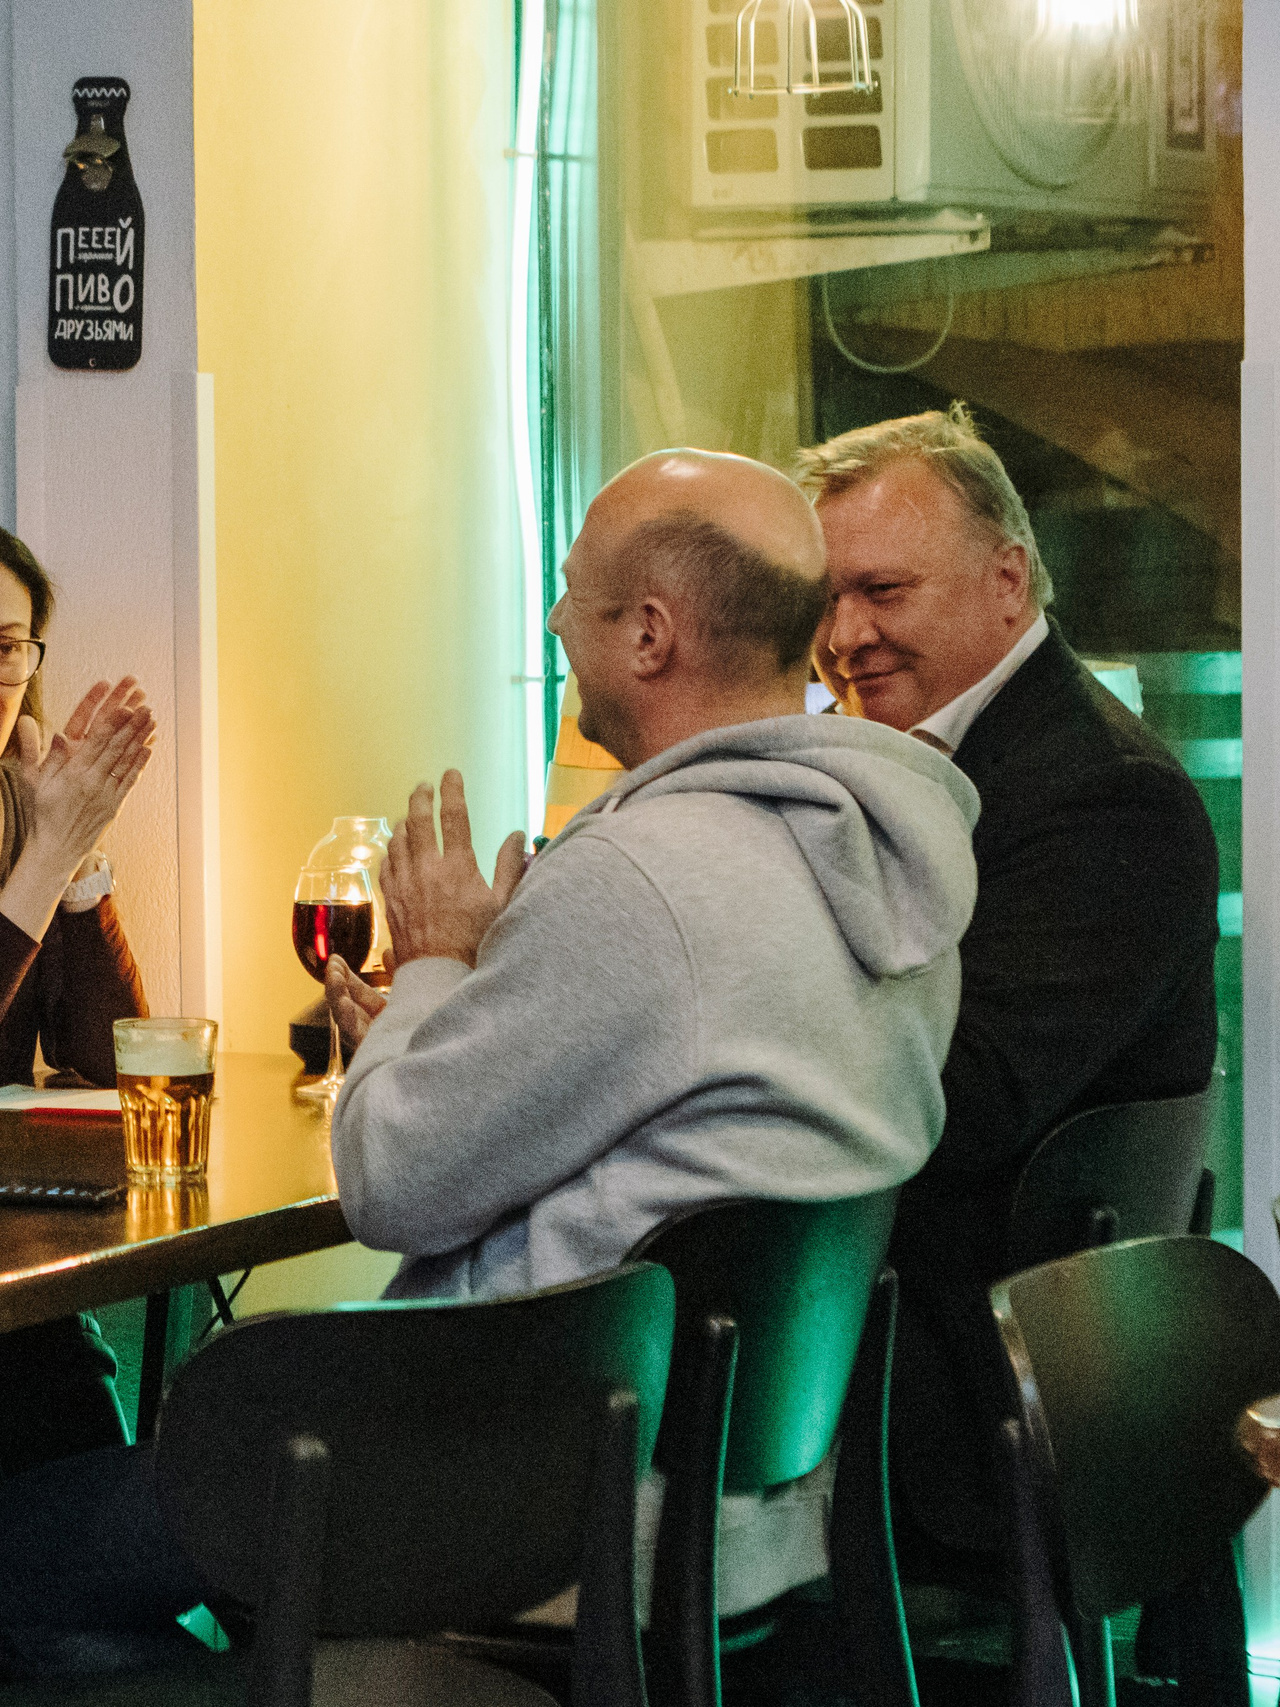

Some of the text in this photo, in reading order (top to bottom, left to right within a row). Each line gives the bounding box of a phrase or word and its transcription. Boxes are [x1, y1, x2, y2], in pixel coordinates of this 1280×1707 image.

[56, 217, 134, 269] ПЕЕЕЙ
[55, 273, 135, 313] ПИВО
[55, 319, 133, 341] ДРУЗЬЯМИ
